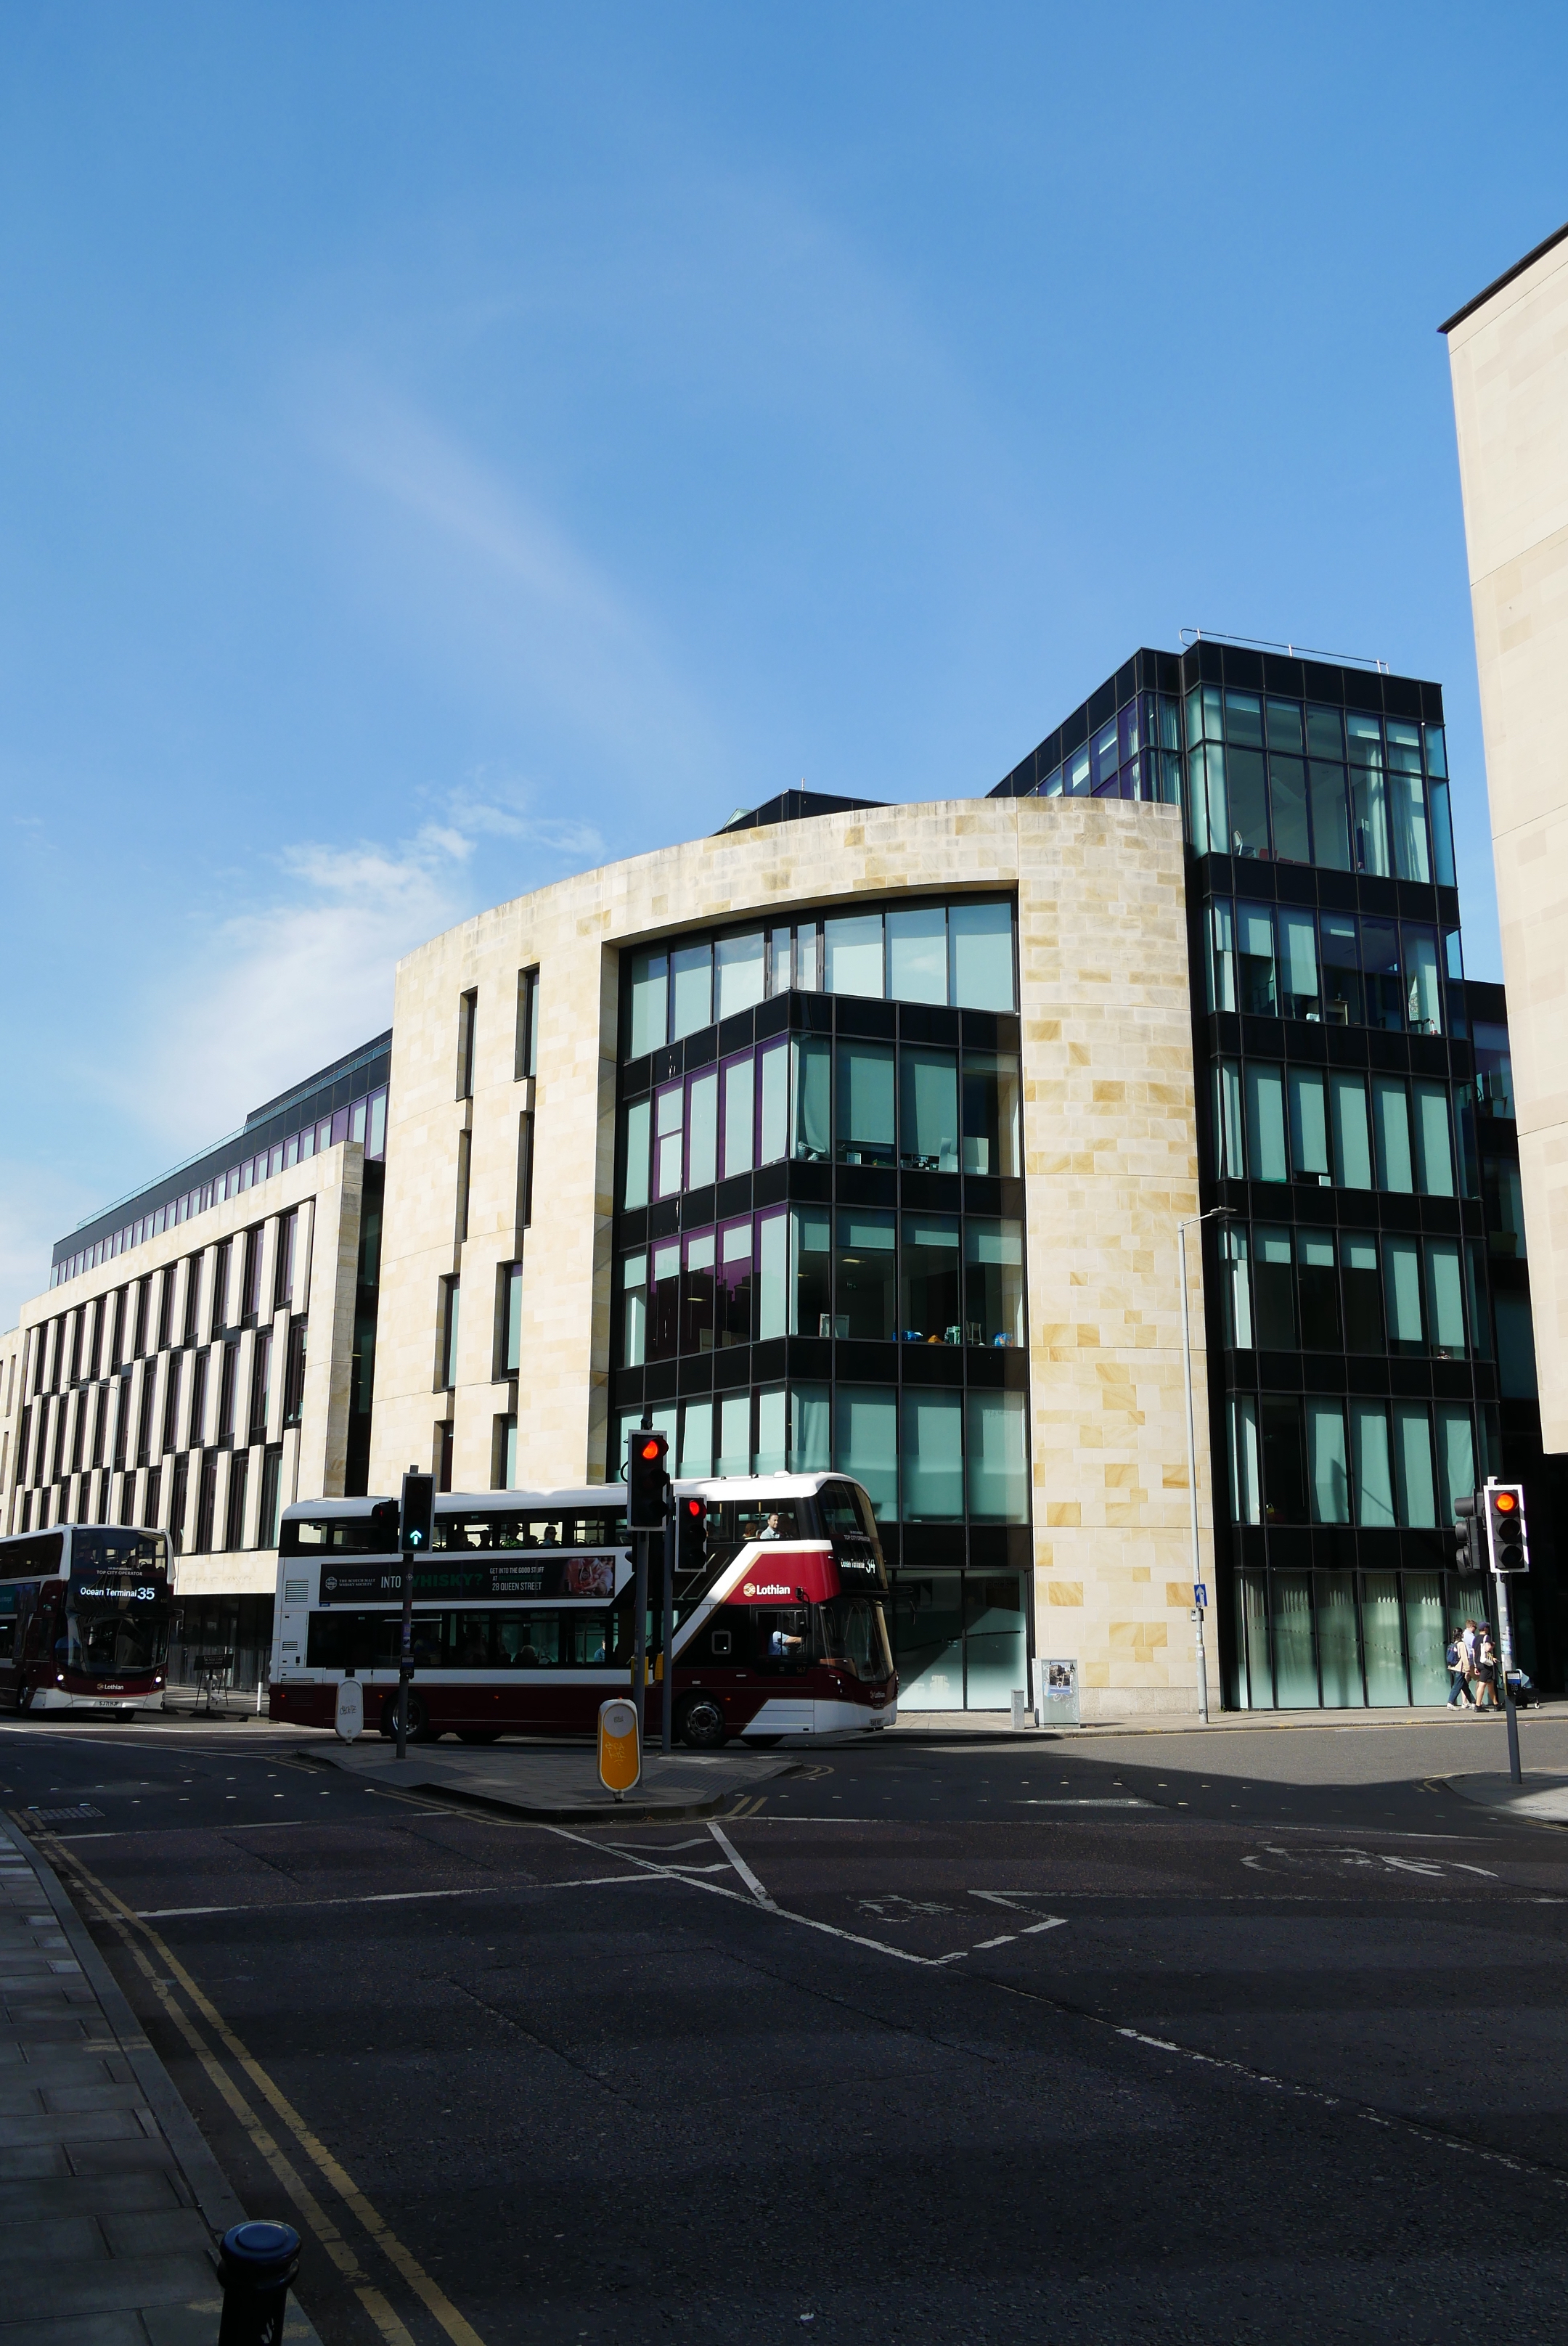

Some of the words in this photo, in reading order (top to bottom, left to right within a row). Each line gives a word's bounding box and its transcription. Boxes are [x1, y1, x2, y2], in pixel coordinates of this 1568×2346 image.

[380, 1576, 401, 1588] INTO
[106, 1588, 137, 1597] Terminal
[137, 1587, 155, 1600] 35
[756, 1585, 791, 1595] Lothian
